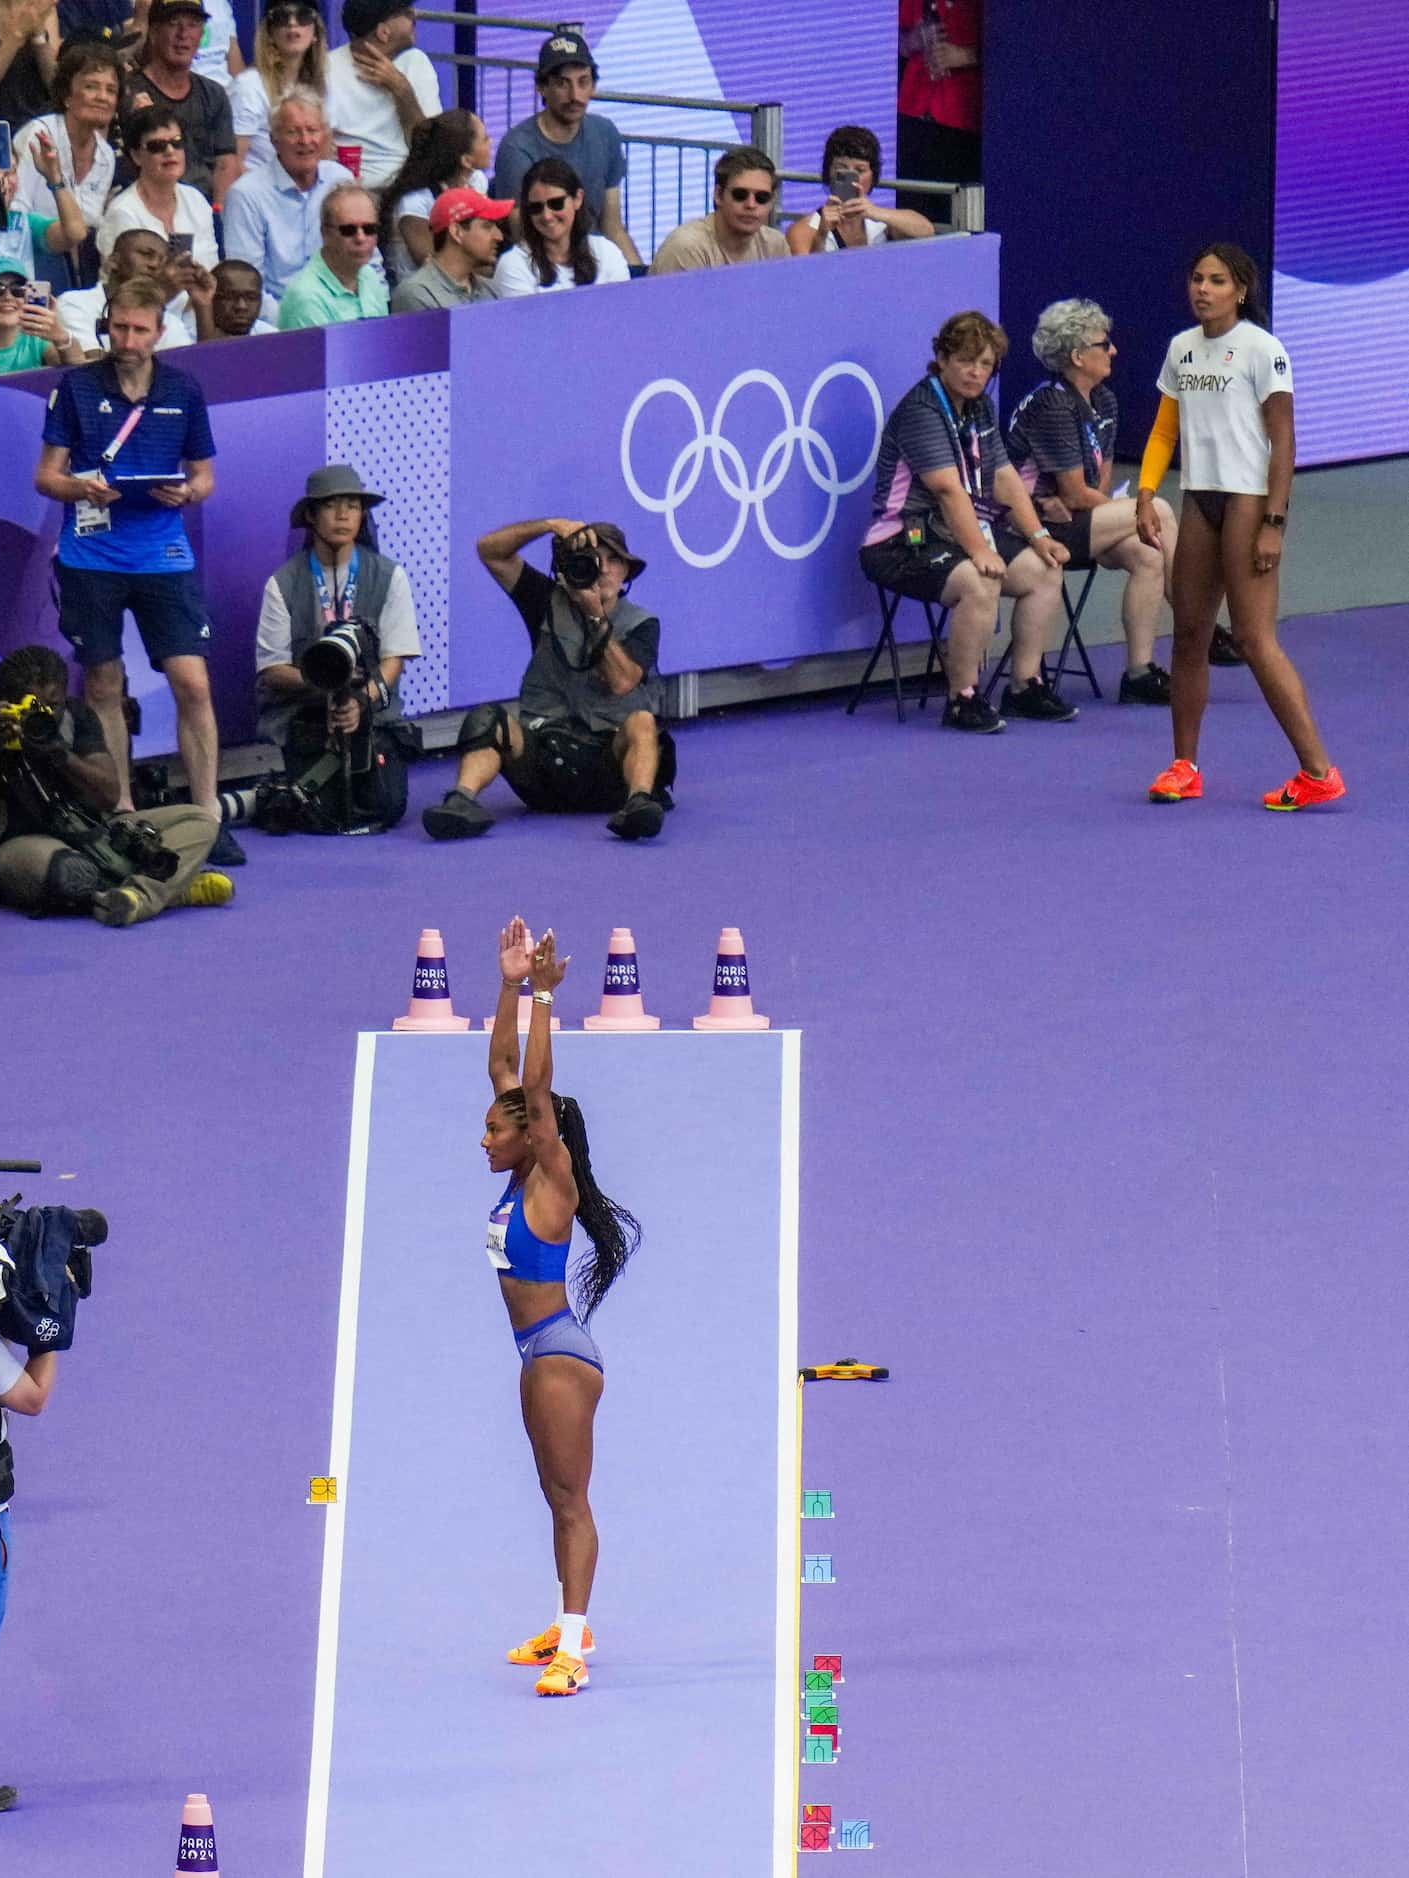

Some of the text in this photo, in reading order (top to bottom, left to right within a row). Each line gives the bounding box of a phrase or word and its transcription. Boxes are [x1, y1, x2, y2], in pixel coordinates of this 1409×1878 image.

[416, 968, 446, 979] PARIS
[607, 965, 636, 975] PARIS
[717, 966, 746, 976] PARIS
[415, 979, 446, 990] 2024
[606, 975, 636, 986] 2024
[716, 976, 746, 987] 2024
[181, 1837, 214, 1849] PARIS
[181, 1848, 214, 1861] 2024
